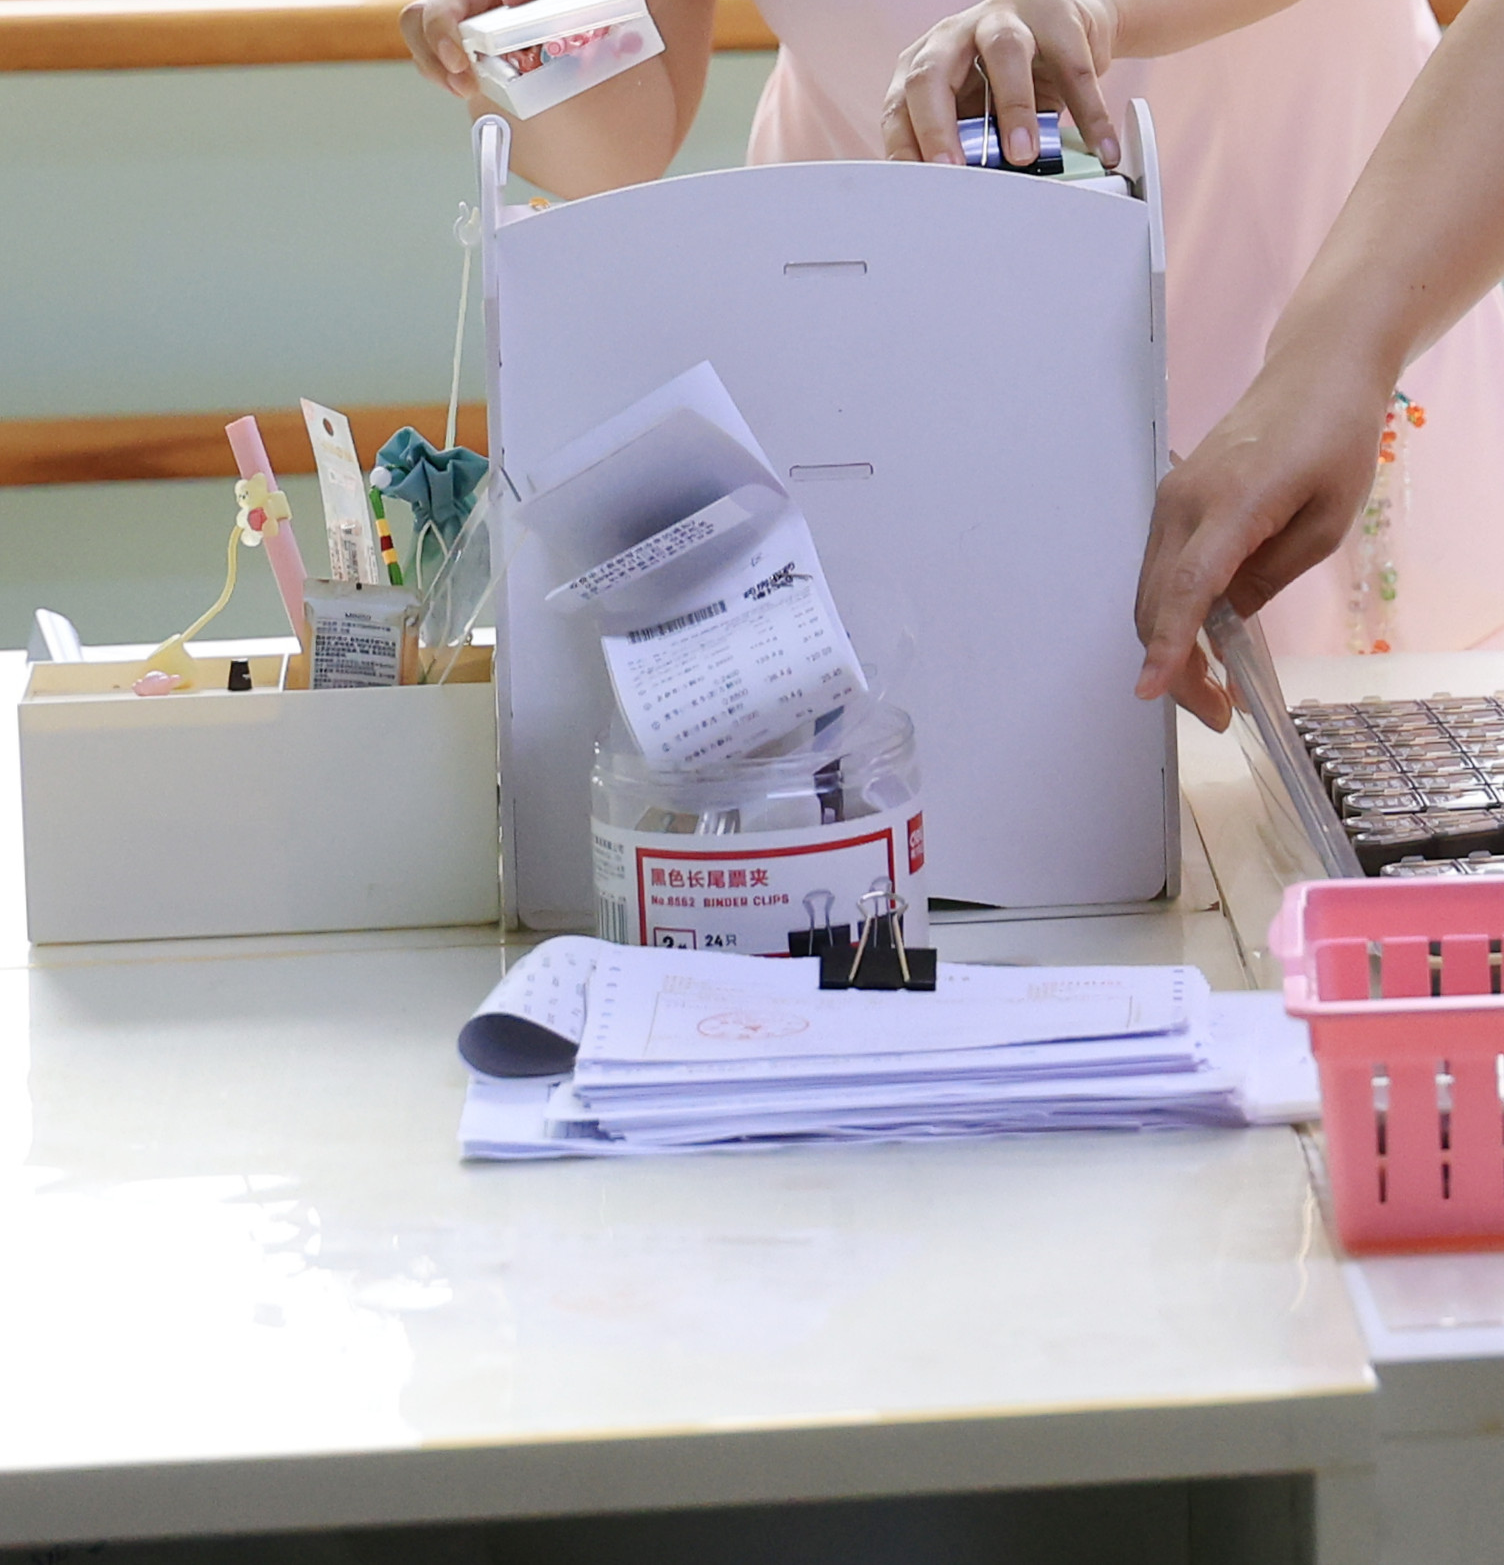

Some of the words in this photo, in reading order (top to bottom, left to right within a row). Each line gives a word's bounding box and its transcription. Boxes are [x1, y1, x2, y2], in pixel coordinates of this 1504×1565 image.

[651, 868, 769, 888] 黑色长尾票夹
[703, 896, 748, 908] BINDER
[753, 894, 789, 906] CLIPS
[705, 934, 737, 947] 24只
